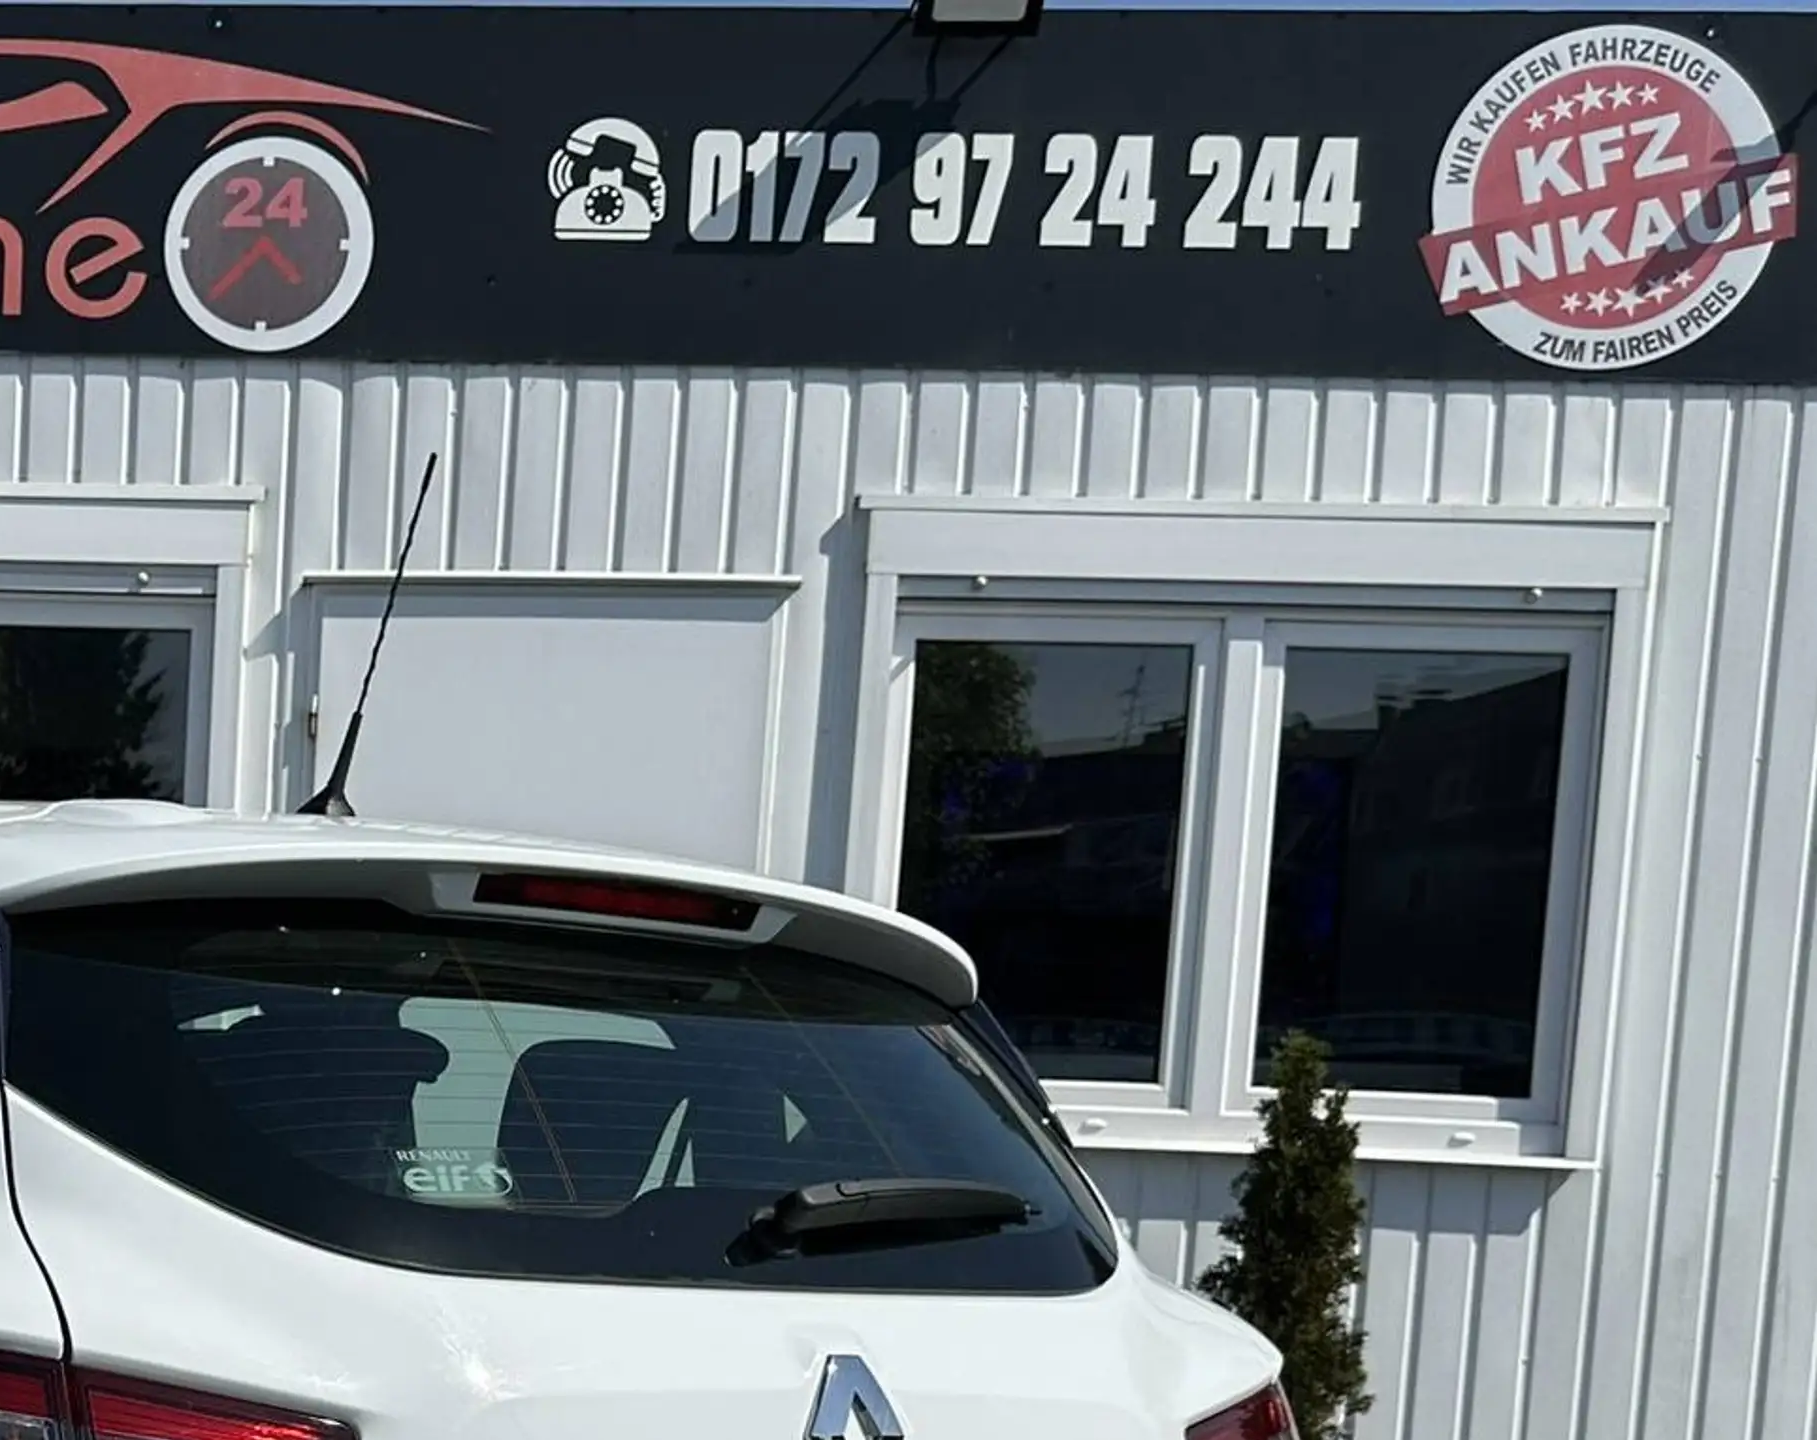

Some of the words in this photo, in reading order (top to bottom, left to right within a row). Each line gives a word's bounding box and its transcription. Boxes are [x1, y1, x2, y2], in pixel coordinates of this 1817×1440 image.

[1446, 136, 1482, 186] WIR
[1471, 51, 1562, 134] KAUFEN
[1568, 36, 1722, 95] FAHRZEUGE
[1514, 112, 1689, 205] KFZ
[222, 176, 309, 229] 24
[688, 129, 880, 243] 0172
[911, 132, 1015, 246] 97
[1039, 133, 1157, 247] 24
[1183, 134, 1362, 250] 244
[1440, 168, 1792, 303] ANKAUF
[1533, 331, 1587, 363] ZUM
[1592, 324, 1676, 364] FAIREN
[1679, 278, 1739, 339] PREIS
